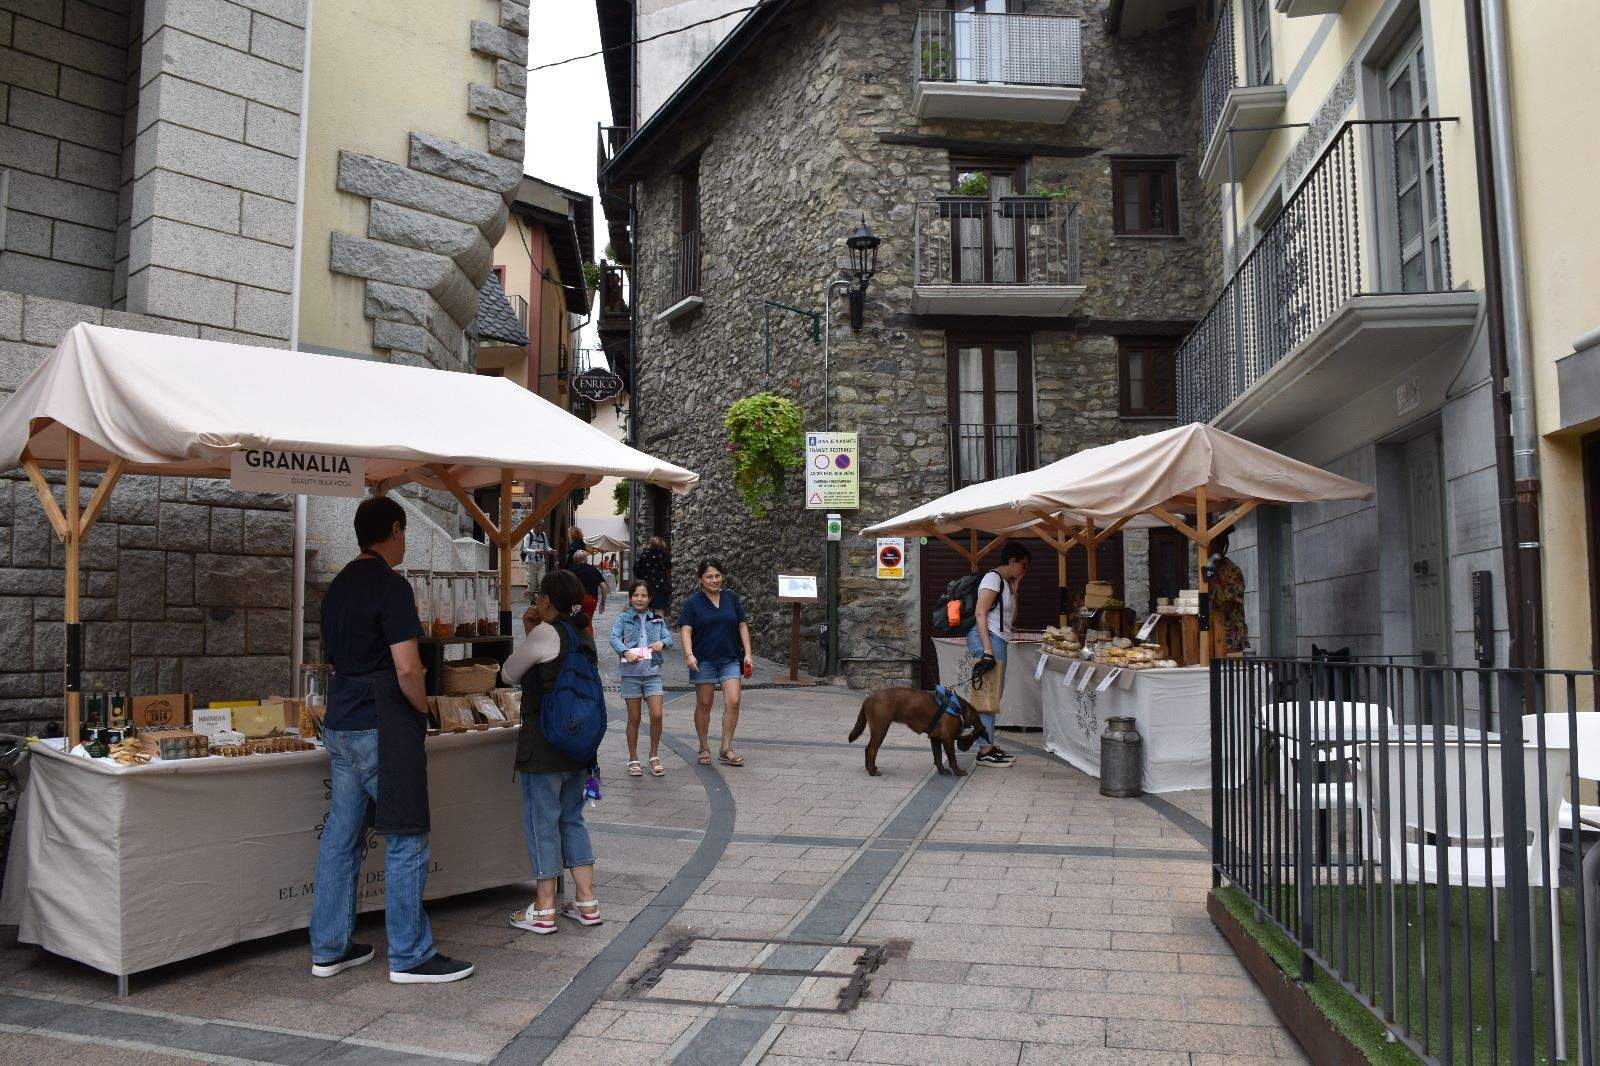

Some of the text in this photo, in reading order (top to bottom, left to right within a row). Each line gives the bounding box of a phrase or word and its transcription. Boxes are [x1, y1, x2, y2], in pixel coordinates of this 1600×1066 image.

[580, 379, 617, 389] ENRICO
[245, 449, 352, 474] GRANALIA
[291, 477, 317, 485] QUALITY
[279, 886, 298, 901] EL
